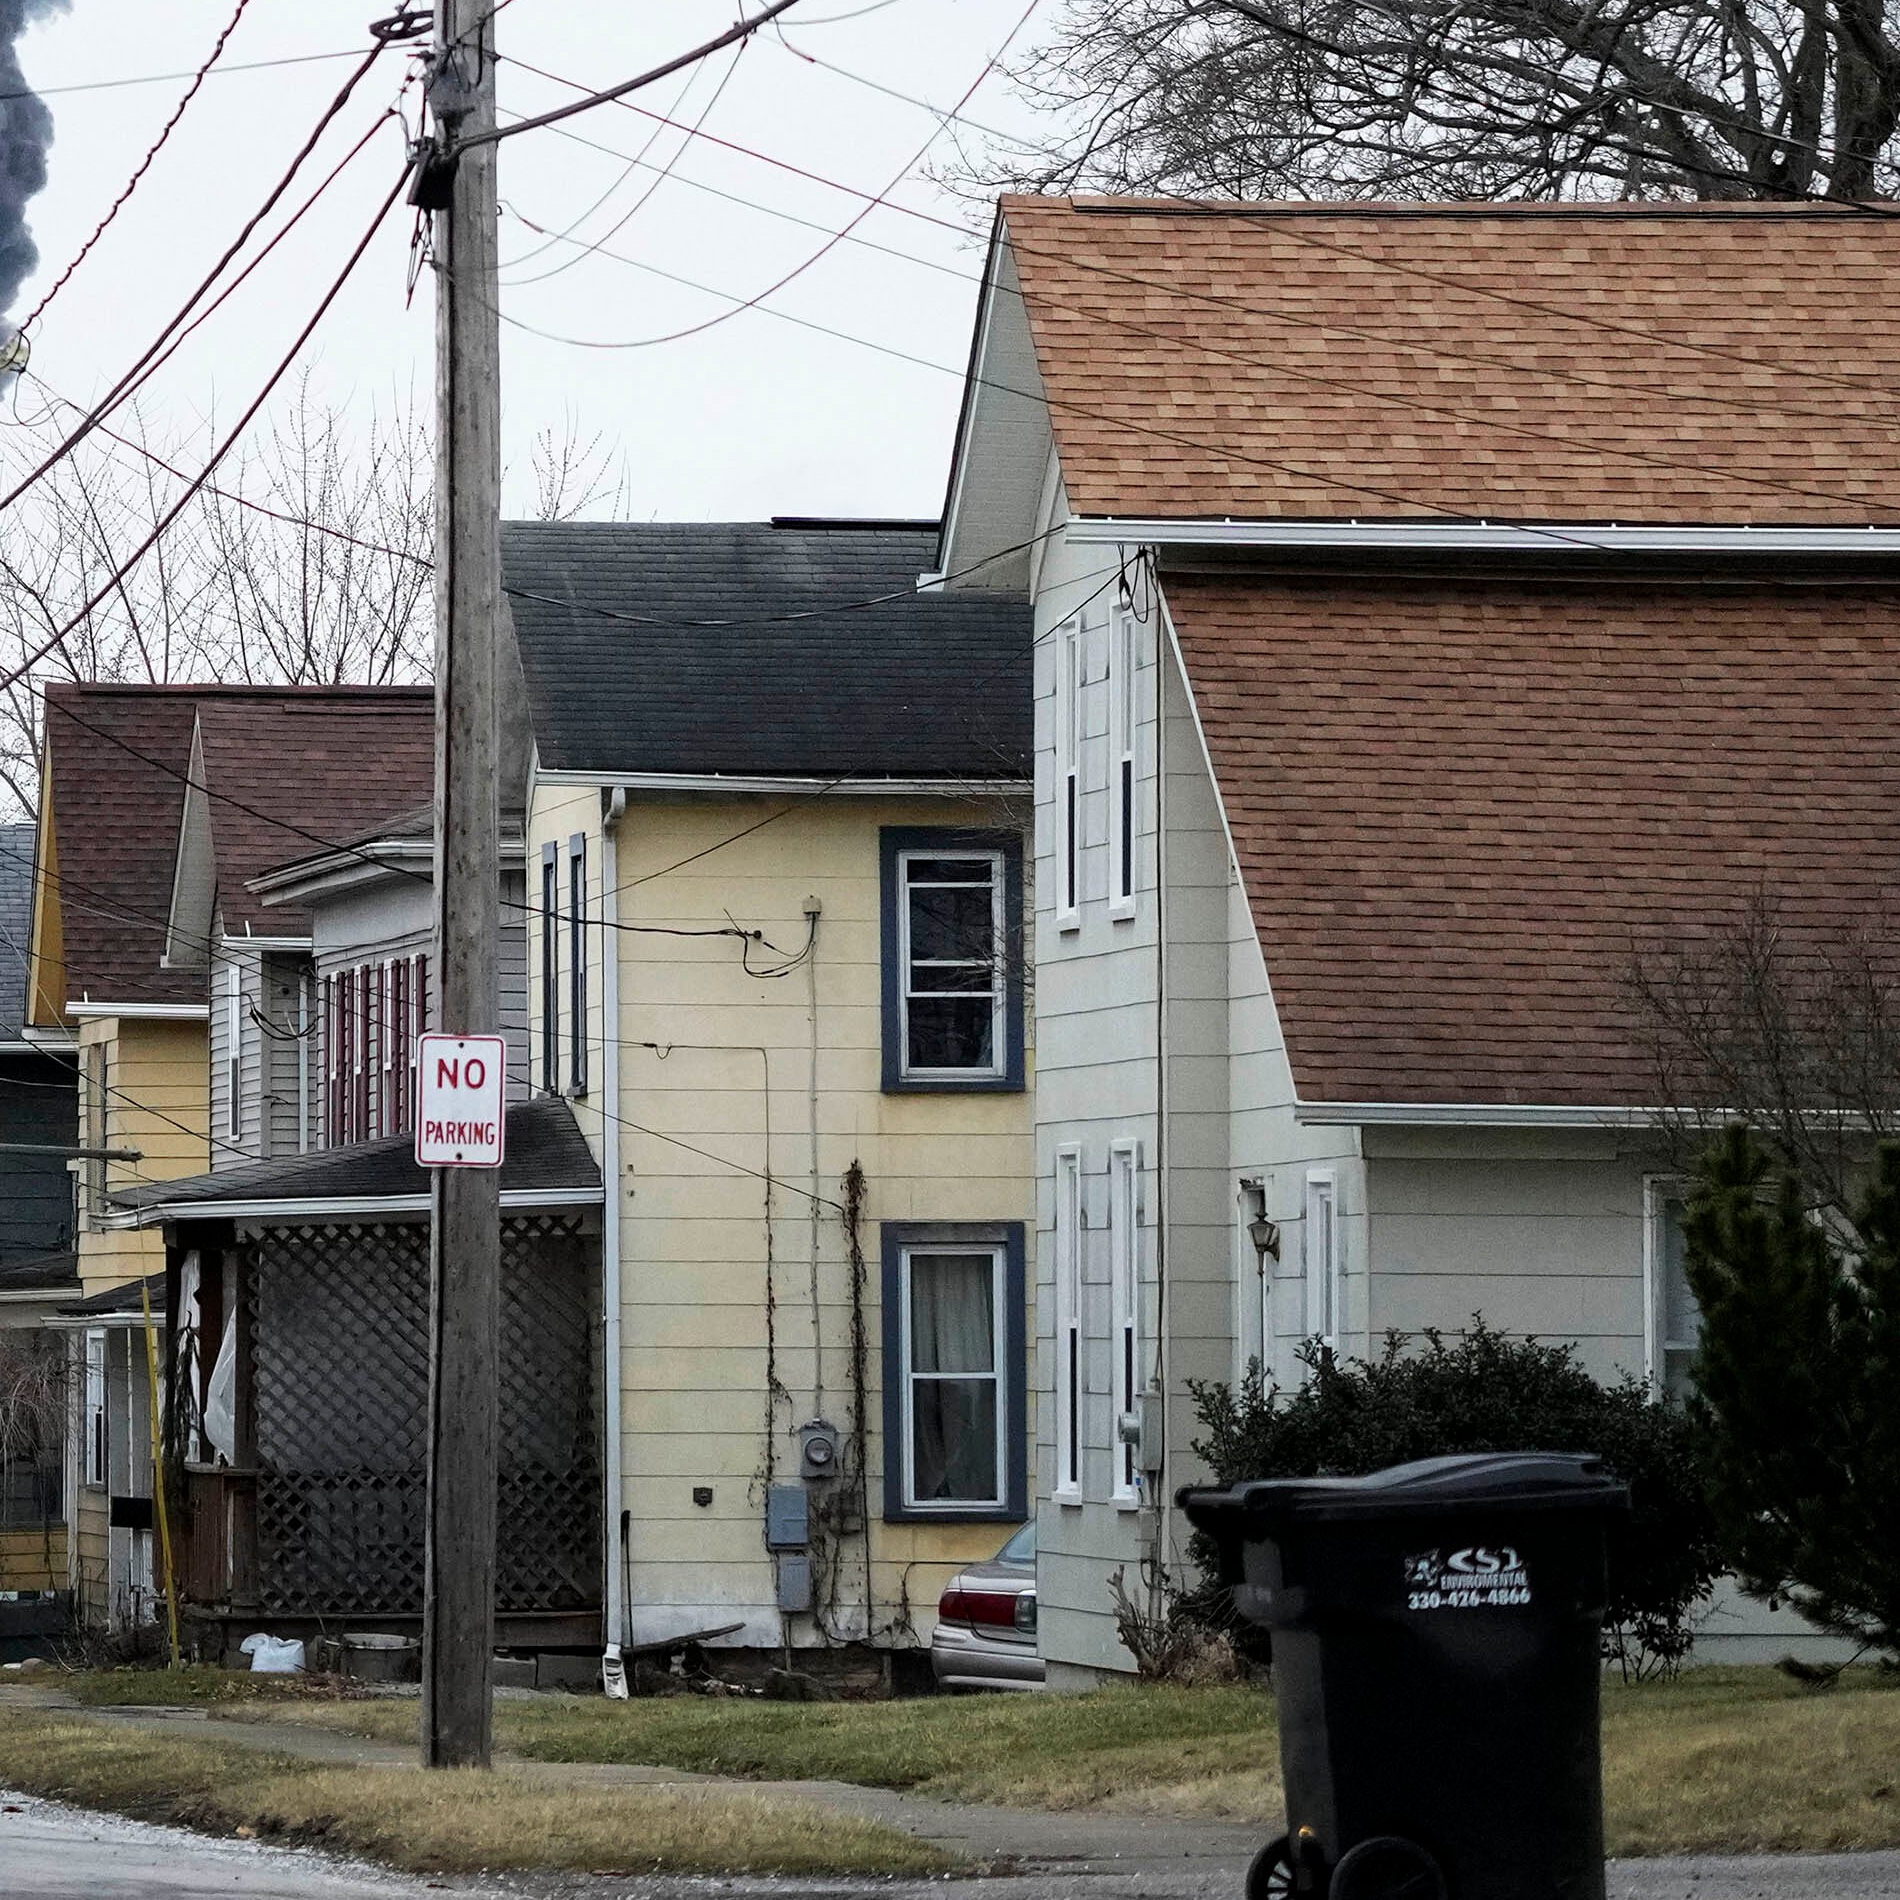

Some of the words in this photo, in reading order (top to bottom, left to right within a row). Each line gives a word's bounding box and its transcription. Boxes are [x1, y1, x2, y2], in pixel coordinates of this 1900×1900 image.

[437, 1058, 486, 1090] NO
[425, 1120, 495, 1146] PARKING
[1408, 1587, 1531, 1610] 330-426-4866
